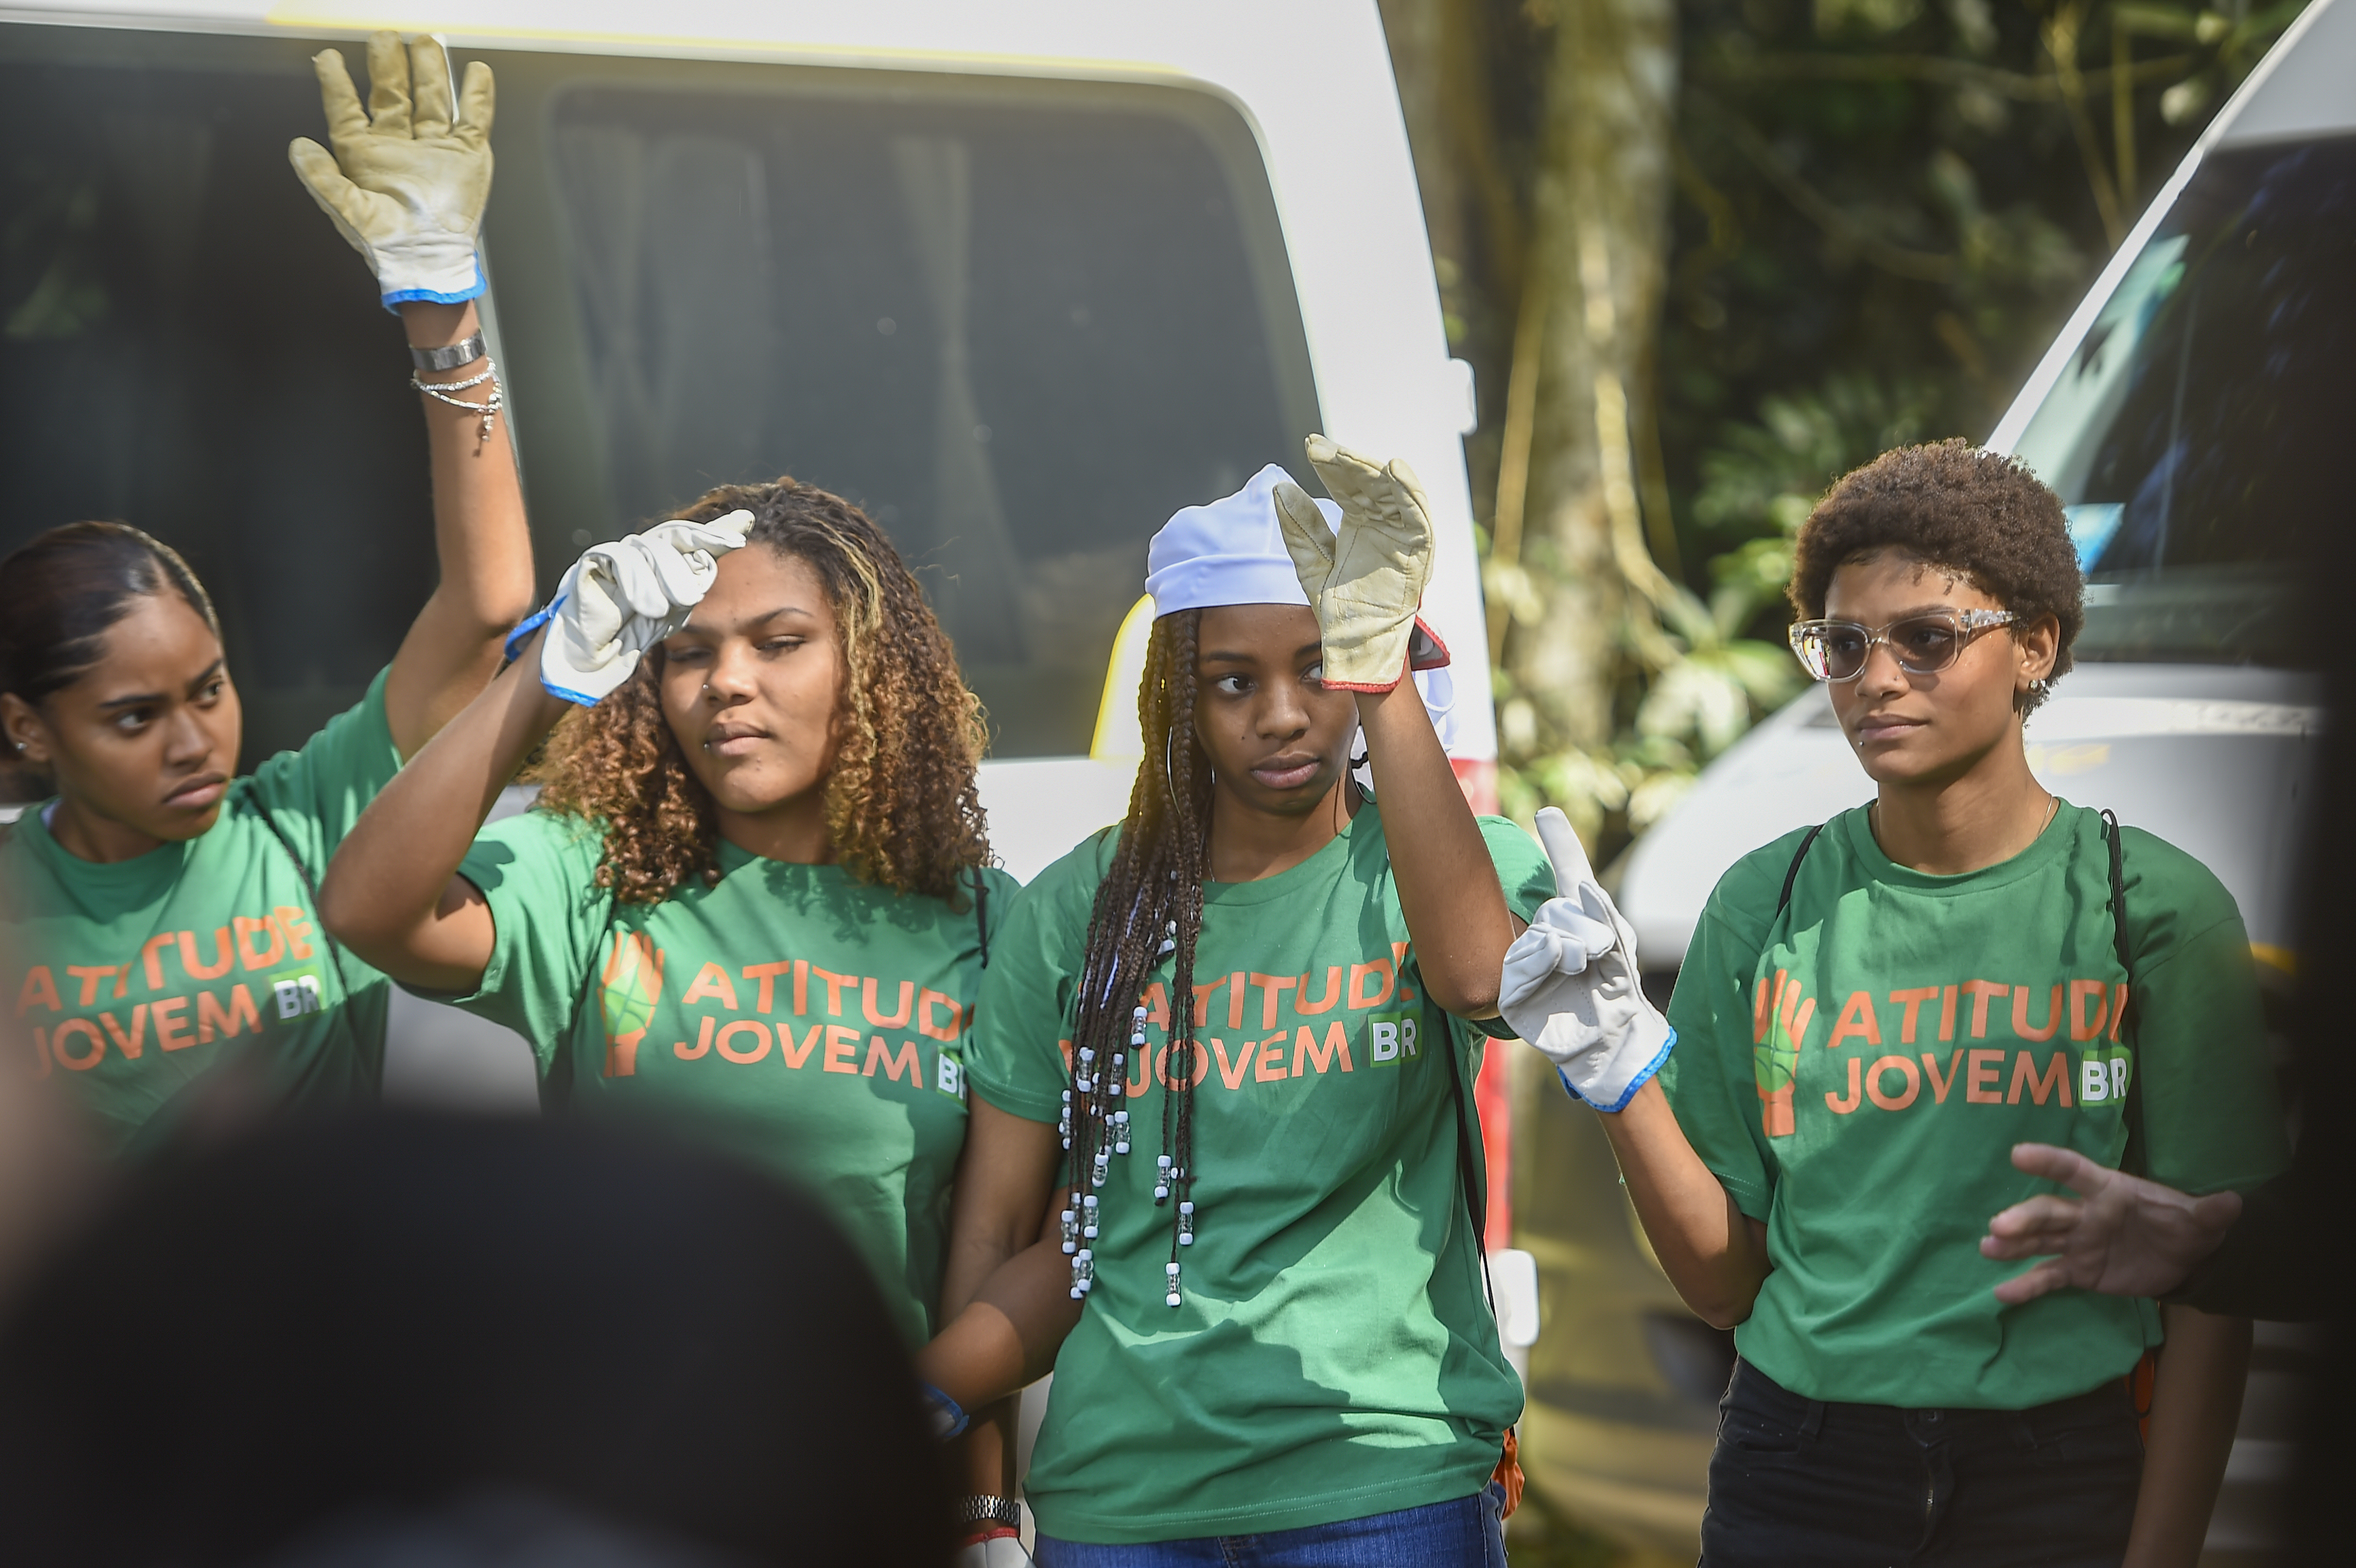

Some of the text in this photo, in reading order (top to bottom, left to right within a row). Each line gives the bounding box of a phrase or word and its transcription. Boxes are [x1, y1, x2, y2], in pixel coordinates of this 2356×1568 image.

[28, 974, 320, 1080] JOVEM BR
[682, 959, 975, 1042] ATITUD
[673, 1016, 923, 1088] JOVEM
[1125, 1018, 1416, 1098] JOVEM BR
[1824, 1049, 2127, 1114] JOVEM BR
